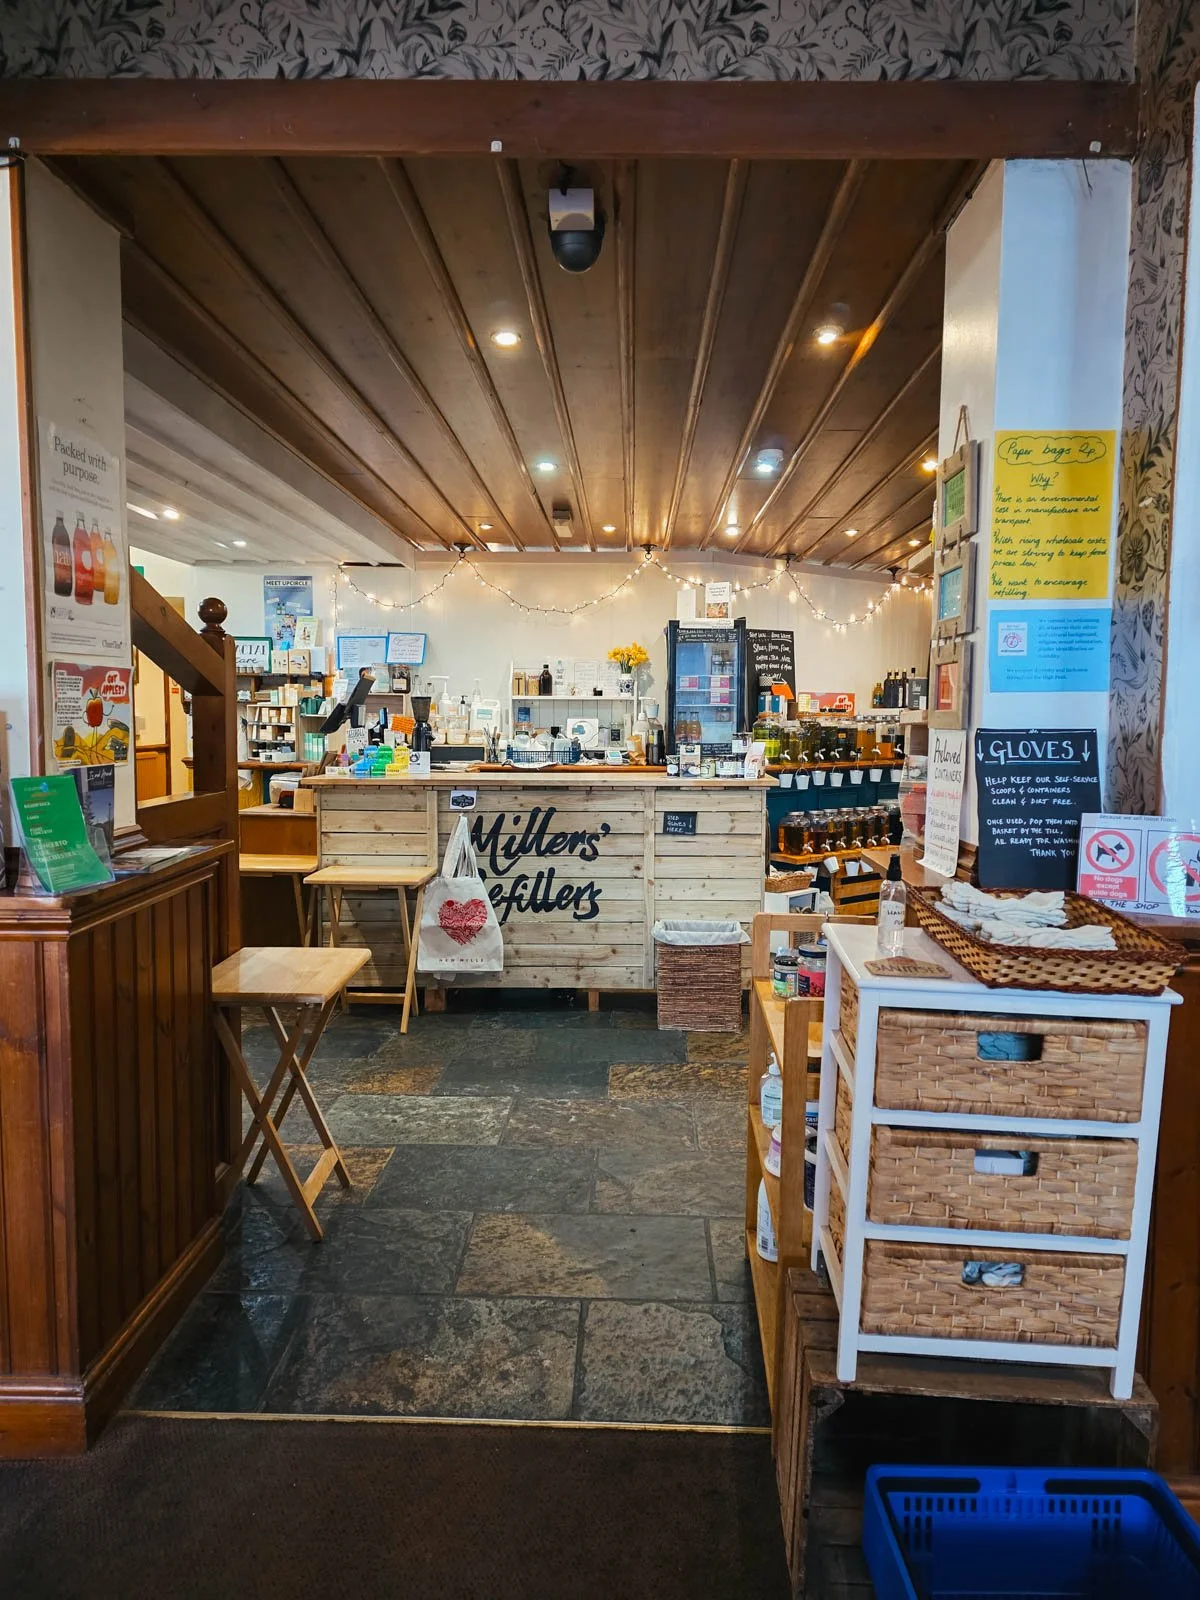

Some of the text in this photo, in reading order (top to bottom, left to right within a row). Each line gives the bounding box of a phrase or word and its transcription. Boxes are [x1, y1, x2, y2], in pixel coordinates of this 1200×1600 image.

[54, 435, 107, 472] Packed with
[1008, 441, 1032, 460] Paper
[1042, 444, 1071, 462] bags
[1031, 472, 1059, 490] Why?
[996, 492, 1012, 502] There
[1040, 494, 1099, 502] environmental
[1025, 506, 1078, 516] manufacture
[994, 536, 1013, 544] With
[1019, 538, 1040, 548] rising
[1046, 535, 1084, 544] wholesale
[1023, 548, 1054, 561] striving
[1070, 549, 1087, 558] keep
[1087, 548, 1107, 558] food
[992, 560, 1016, 569] prices
[992, 578, 1002, 586] We
[1034, 577, 1041, 585] to
[1043, 579, 1088, 590] encourage
[989, 740, 1074, 765] GLOVES
[985, 777, 1007, 787] HELP
[1011, 776, 1031, 784] KEEP
[991, 787, 1016, 795] SCOOPS
[1019, 785, 1024, 795] &
[1021, 797, 1026, 806] &
[986, 818, 1003, 826] ONCE
[992, 827, 1017, 835] BASKET
[471, 807, 611, 876] Millers'
[1010, 838, 1032, 846] READY
[1029, 848, 1076, 858] THANK YOU
[1105, 875, 1123, 884] dogs
[1110, 891, 1128, 899] dogs
